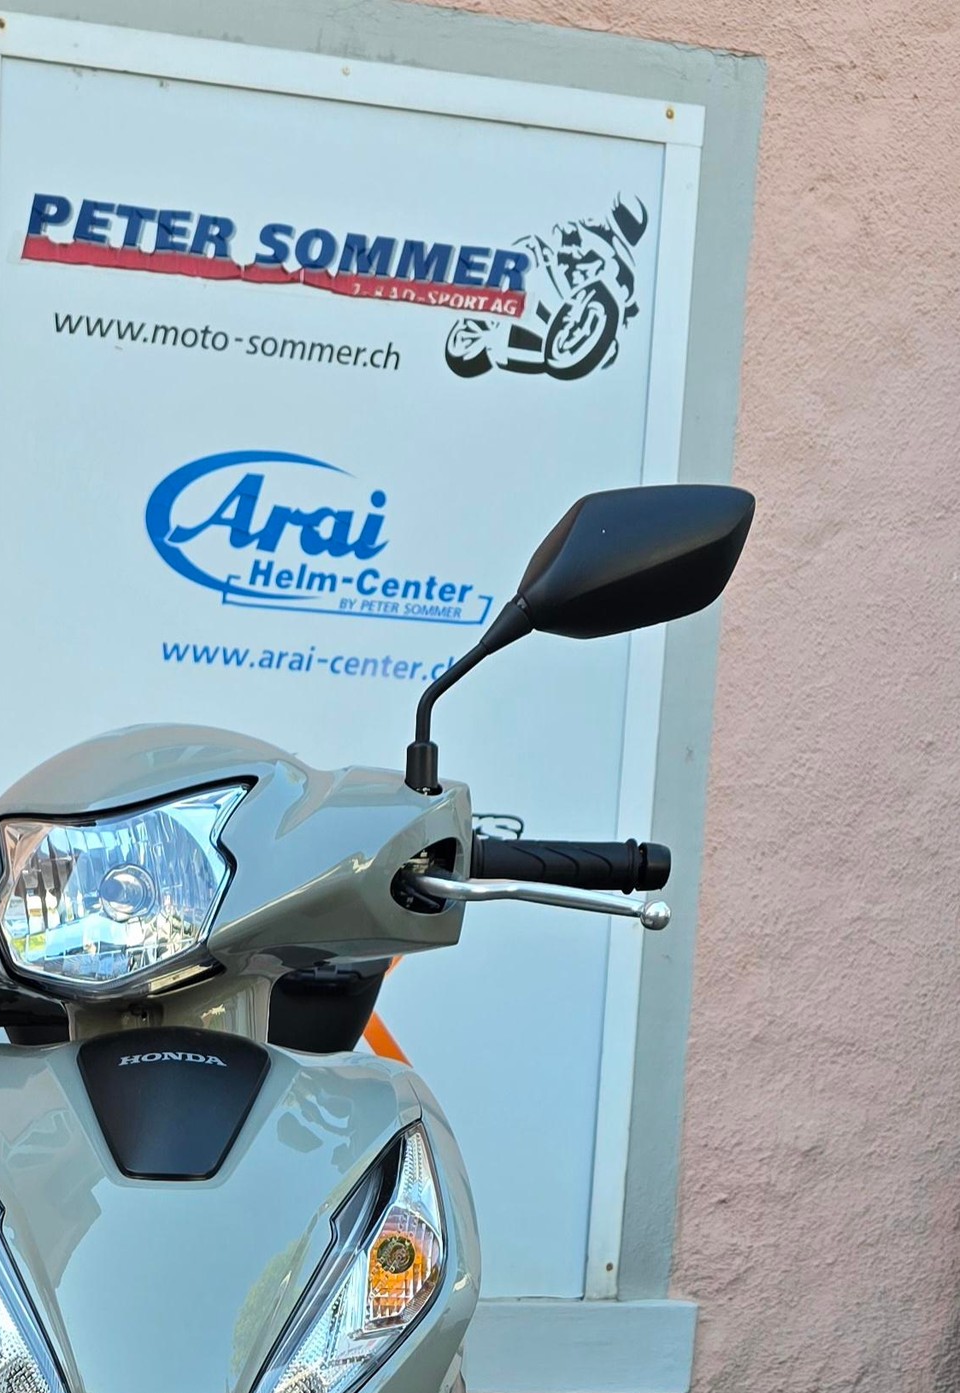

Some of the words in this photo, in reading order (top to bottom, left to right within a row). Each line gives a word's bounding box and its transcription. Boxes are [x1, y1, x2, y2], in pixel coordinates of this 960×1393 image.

[28, 193, 237, 259] PETER
[251, 222, 534, 292] SOMMER
[490, 298, 519, 316] AG
[53, 311, 402, 371] www.moto-sommer.ch
[167, 472, 390, 561] Arai
[248, 558, 474, 602] Helm-Center
[339, 597, 358, 611] BY
[360, 599, 400, 614] PETER
[403, 602, 463, 619] SOMMER
[118, 1051, 228, 1067] HONDA
